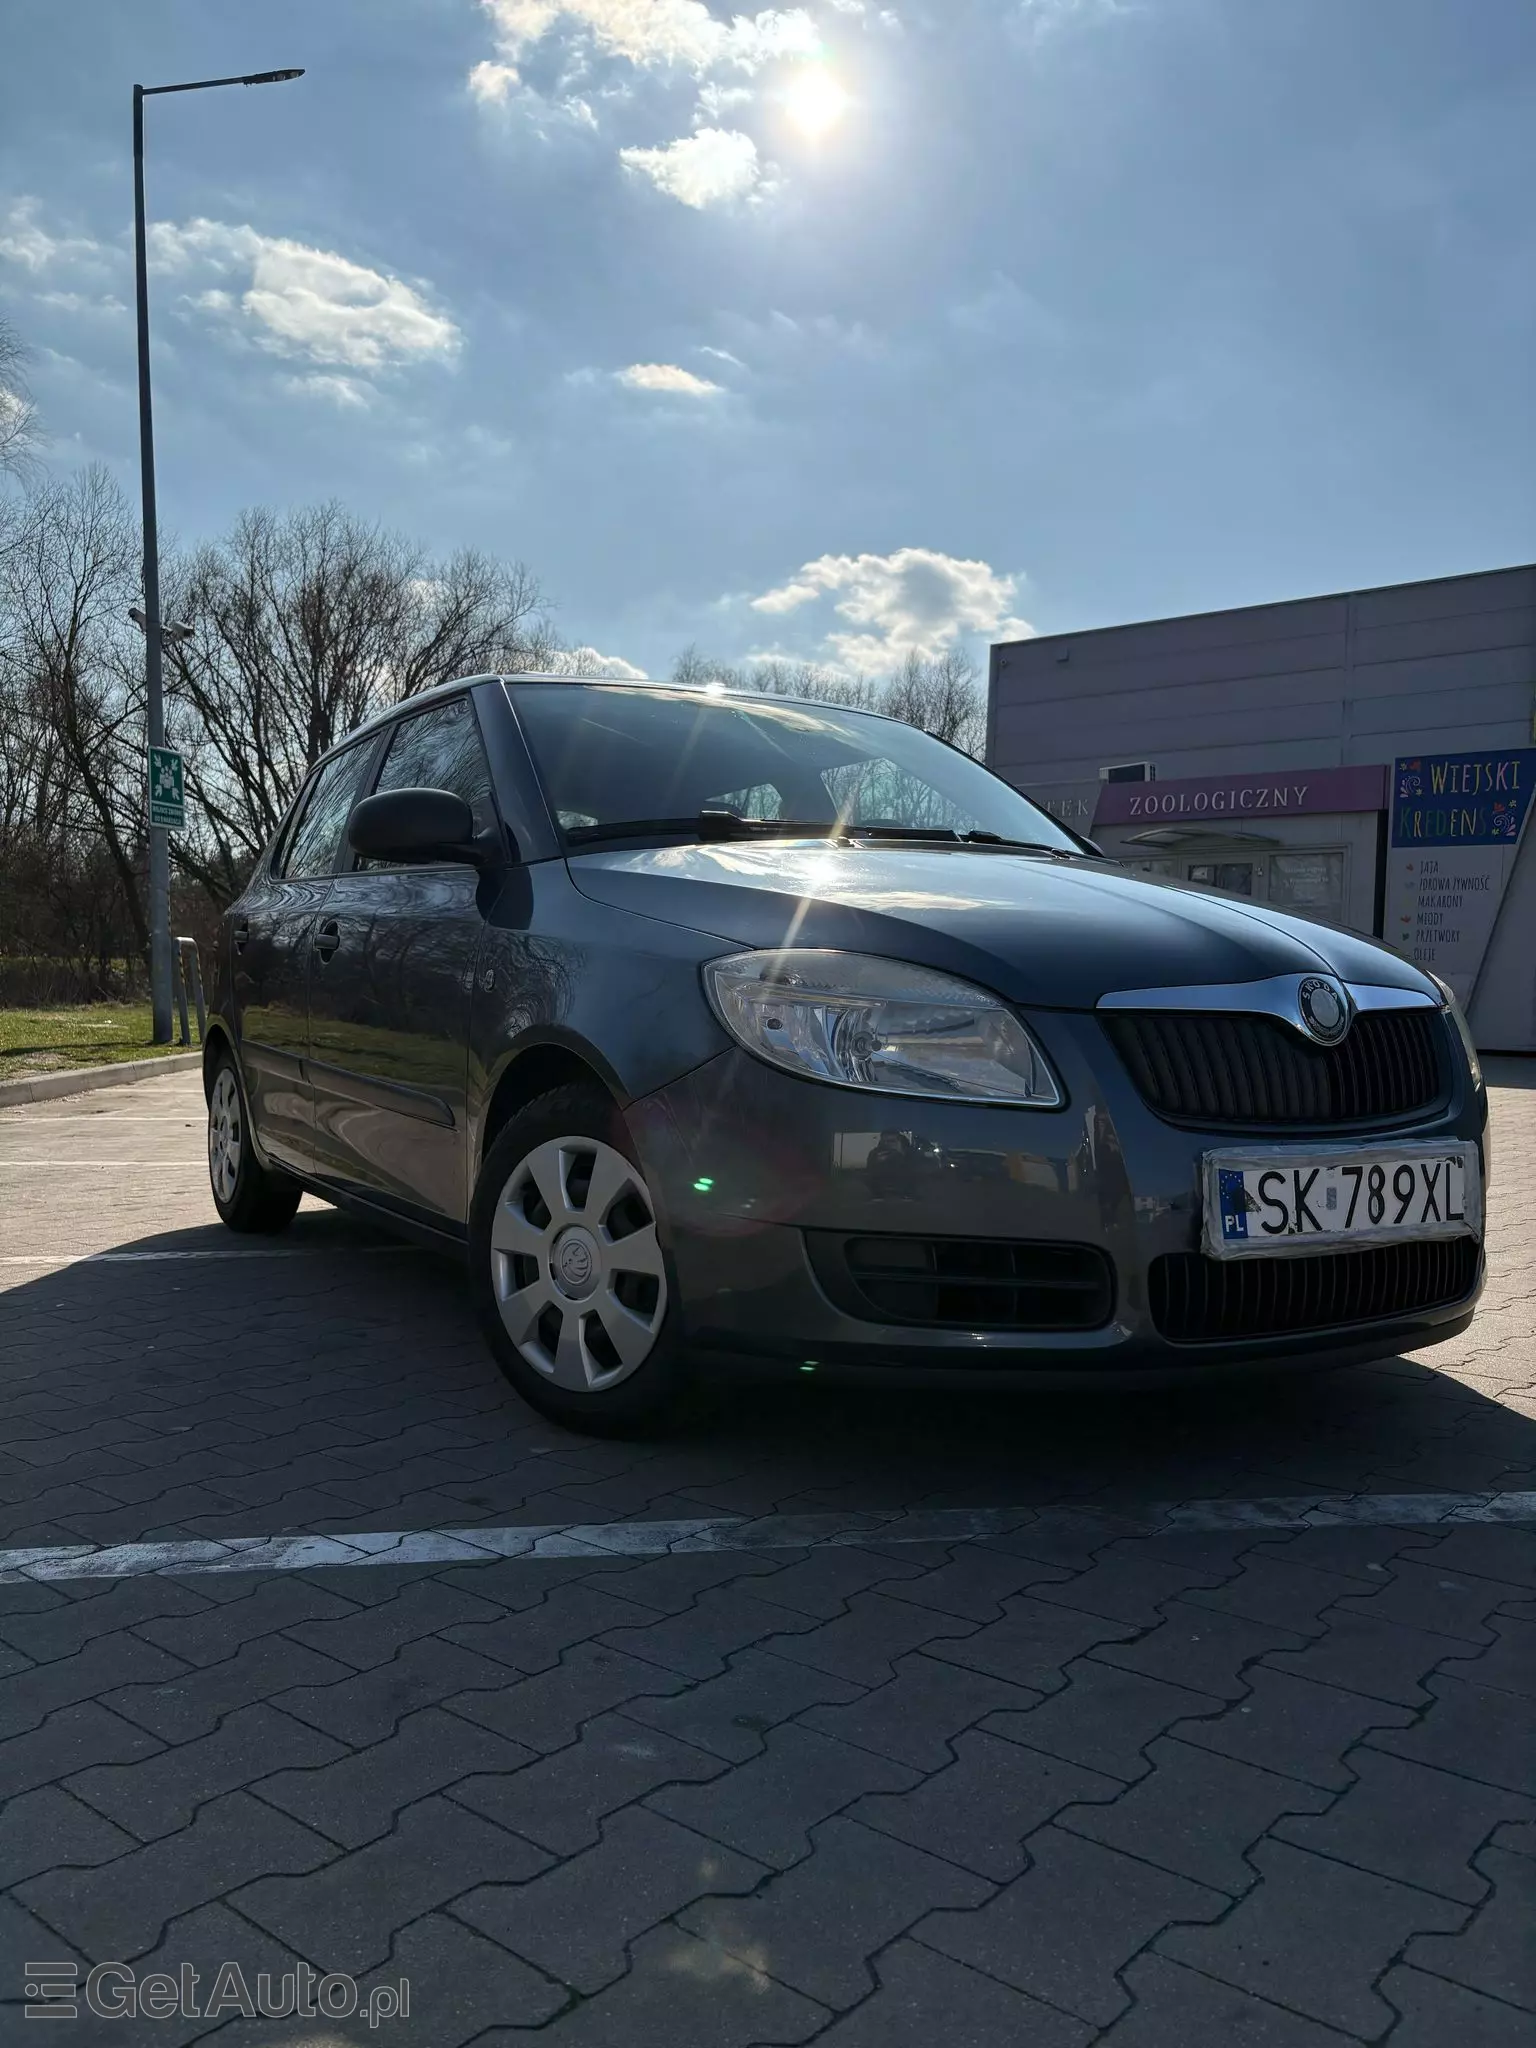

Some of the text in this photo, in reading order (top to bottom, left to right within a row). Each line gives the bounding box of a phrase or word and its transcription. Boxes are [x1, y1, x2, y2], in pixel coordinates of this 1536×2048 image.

[1431, 762, 1520, 795] WIEJSKI
[1130, 786, 1308, 816] ZOOLOGICZNY
[1400, 807, 1487, 838] KREDENS
[1420, 861, 1439, 875] JAJA
[1418, 895, 1463, 909] MAKARONY
[1416, 929, 1460, 943] PRZETWORY
[1413, 947, 1437, 962] OLEJE
[1258, 1163, 1464, 1234] SK 789XL
[1225, 1215, 1244, 1232] PL
